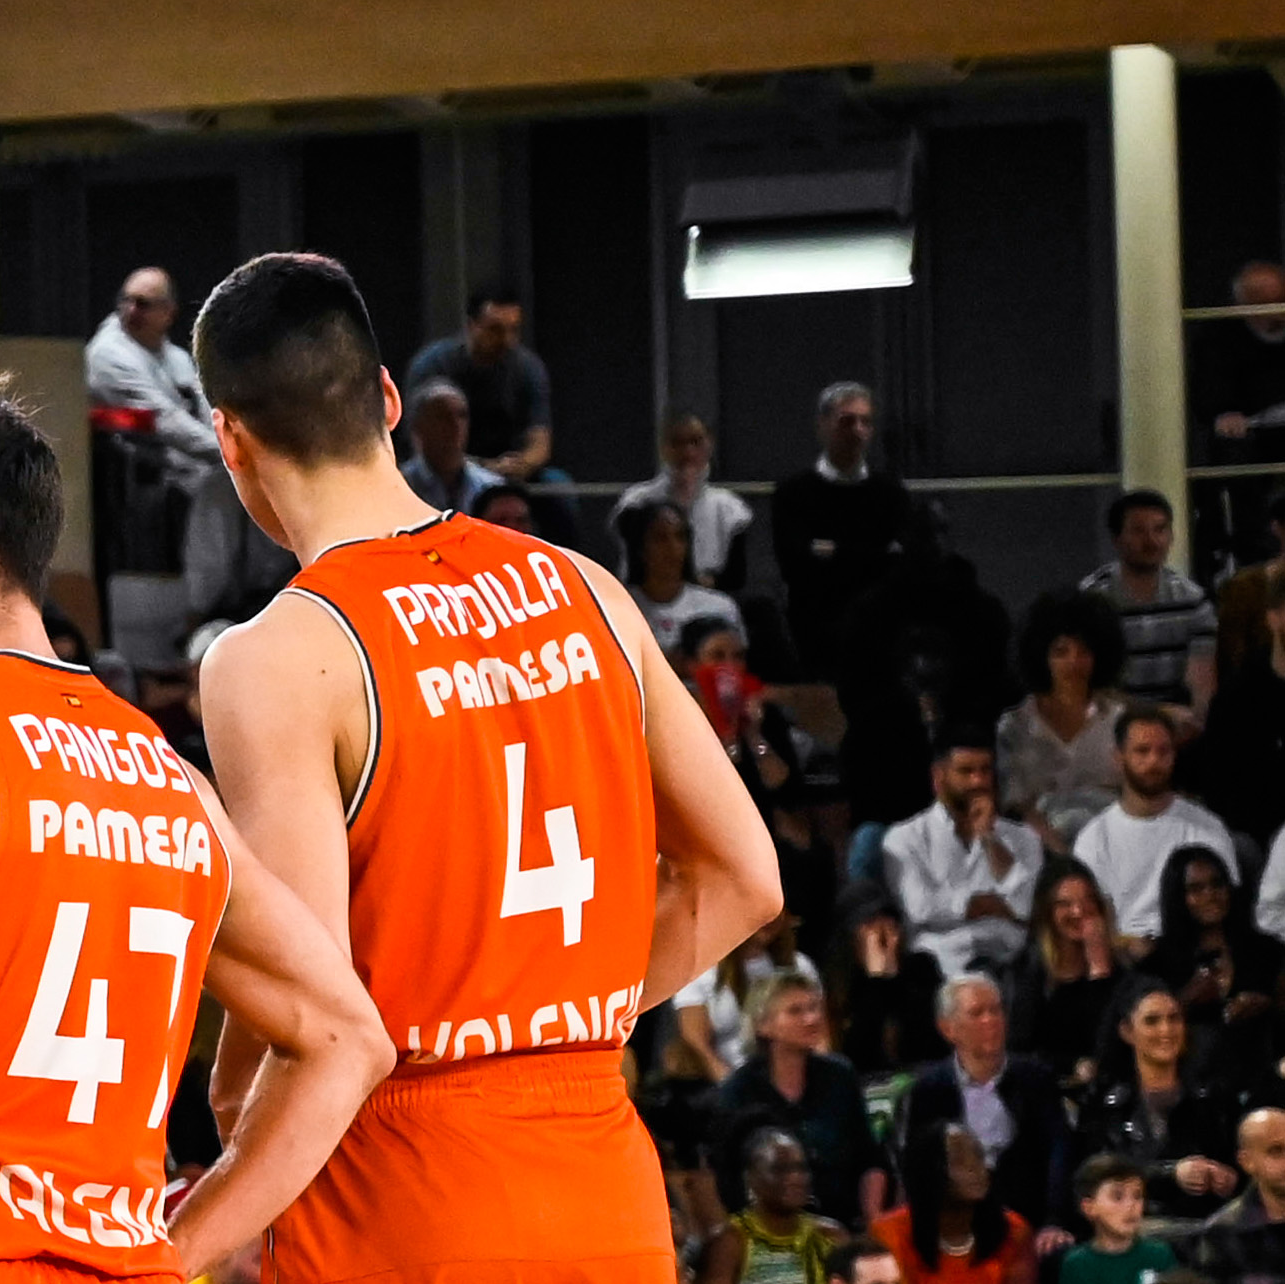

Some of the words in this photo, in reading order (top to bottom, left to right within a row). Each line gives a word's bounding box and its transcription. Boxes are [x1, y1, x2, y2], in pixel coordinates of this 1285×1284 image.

[415, 632, 600, 718] PAMESA
[9, 712, 192, 795] PANGOS
[29, 799, 211, 877] PAMESA
[500, 742, 594, 947] 4
[7, 901, 194, 1129] 47
